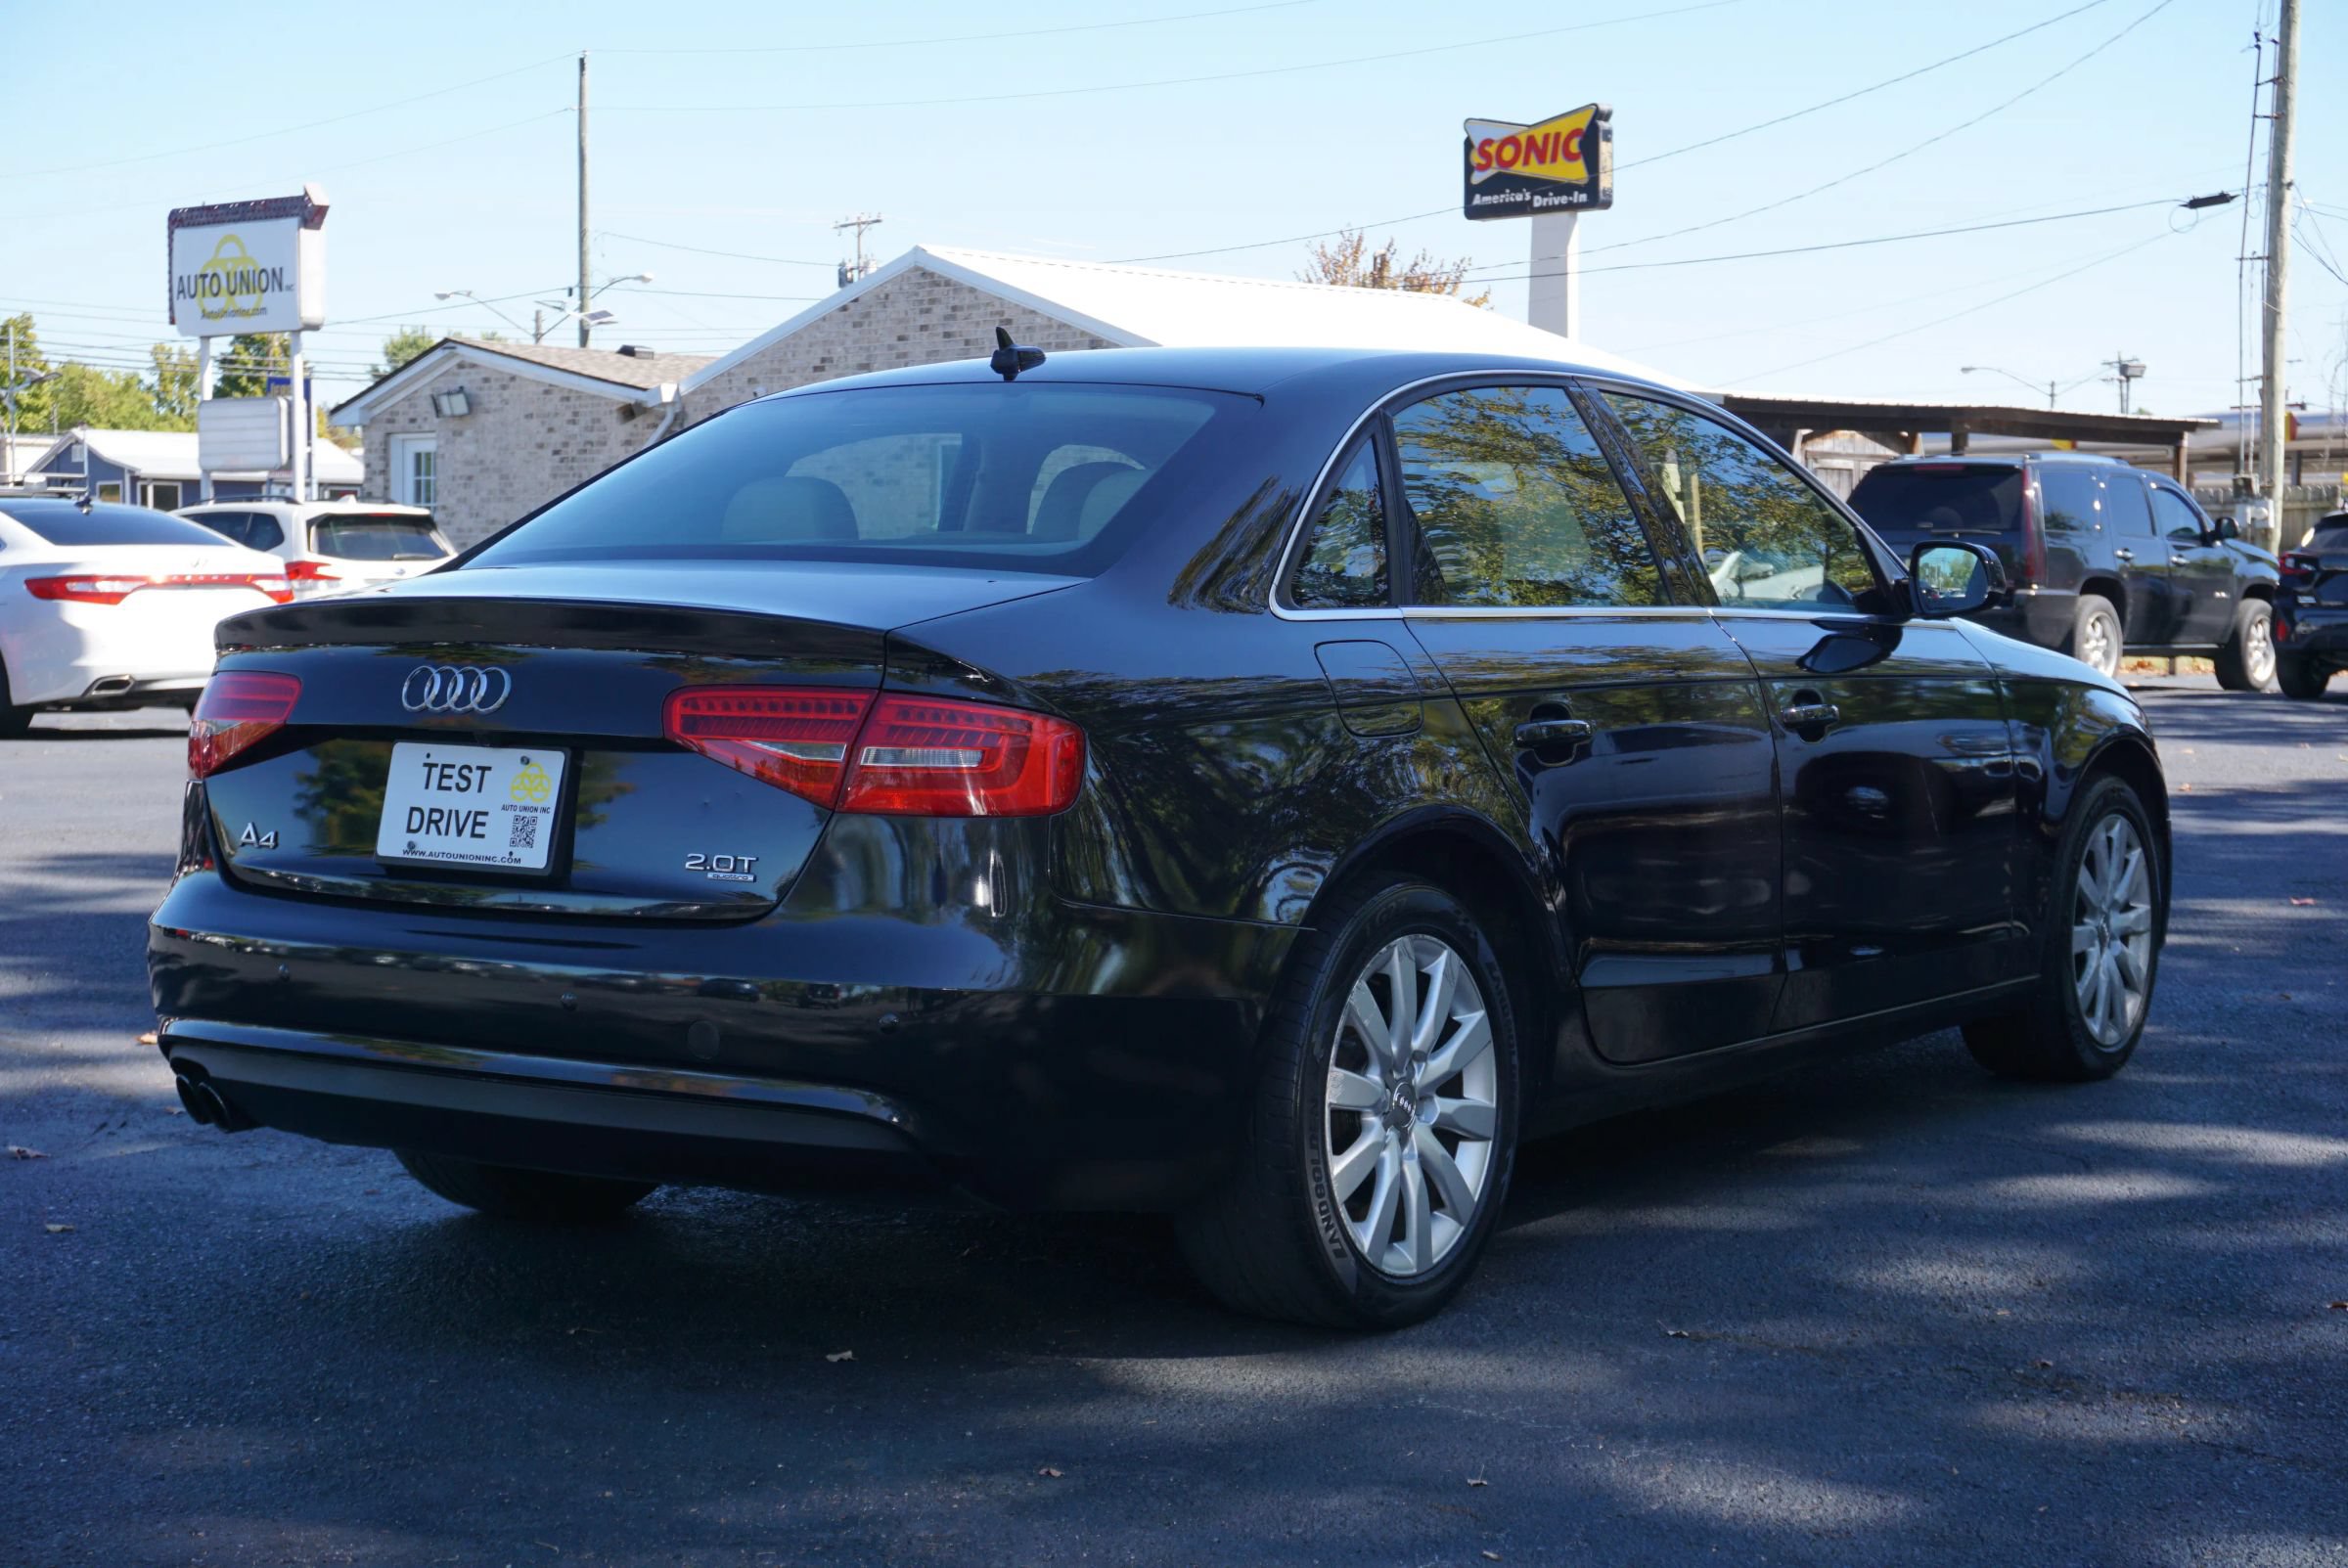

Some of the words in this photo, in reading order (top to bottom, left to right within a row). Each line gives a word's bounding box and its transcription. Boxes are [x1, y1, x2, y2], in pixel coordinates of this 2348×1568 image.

[1474, 127, 1584, 172] SONIC
[1472, 189, 1531, 205] America's
[1533, 191, 1588, 207] Drive-In
[176, 272, 221, 300] AUTO
[226, 267, 284, 296] UNION
[423, 761, 492, 793] TEST
[406, 806, 489, 839] DRIVE
[501, 804, 519, 813] AUTO
[519, 804, 538, 814] UNION
[240, 822, 277, 849] A4
[402, 848, 521, 865] WWW.AUTOUNIONINC.COM
[685, 853, 757, 874] 2.0T
